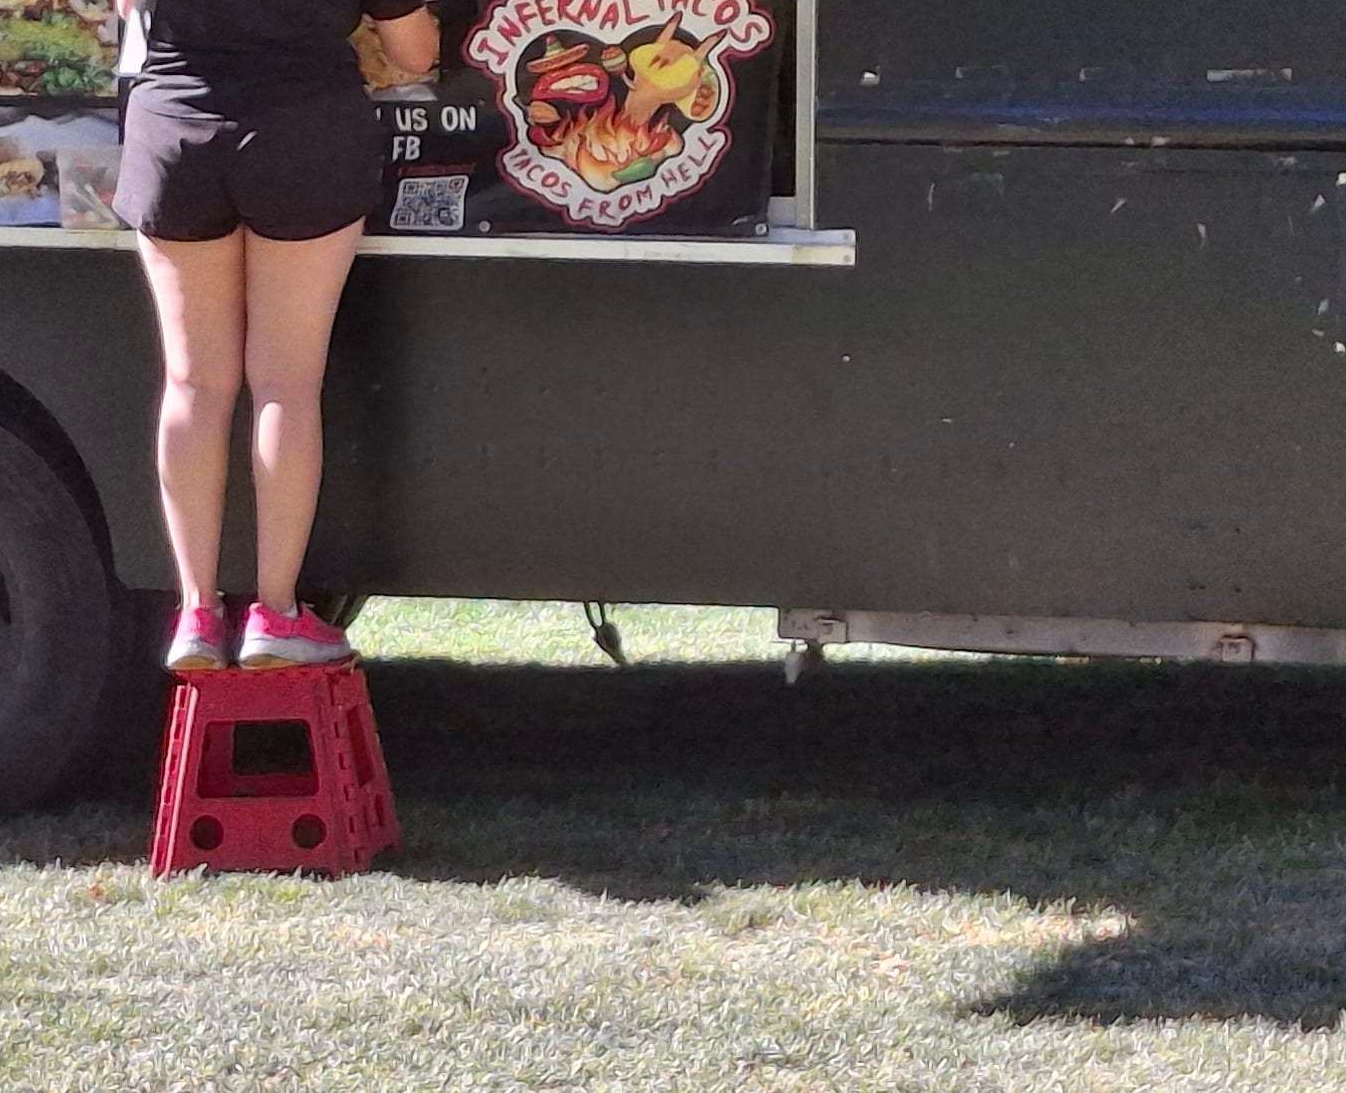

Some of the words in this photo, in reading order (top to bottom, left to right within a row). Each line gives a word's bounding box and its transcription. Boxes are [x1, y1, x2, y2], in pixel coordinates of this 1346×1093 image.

[395, 107, 429, 131] US
[440, 105, 476, 131] ON
[392, 135, 421, 161] FB
[510, 147, 572, 198] TACOS
[577, 184, 654, 219] FROM
[660, 136, 717, 188] HELL
